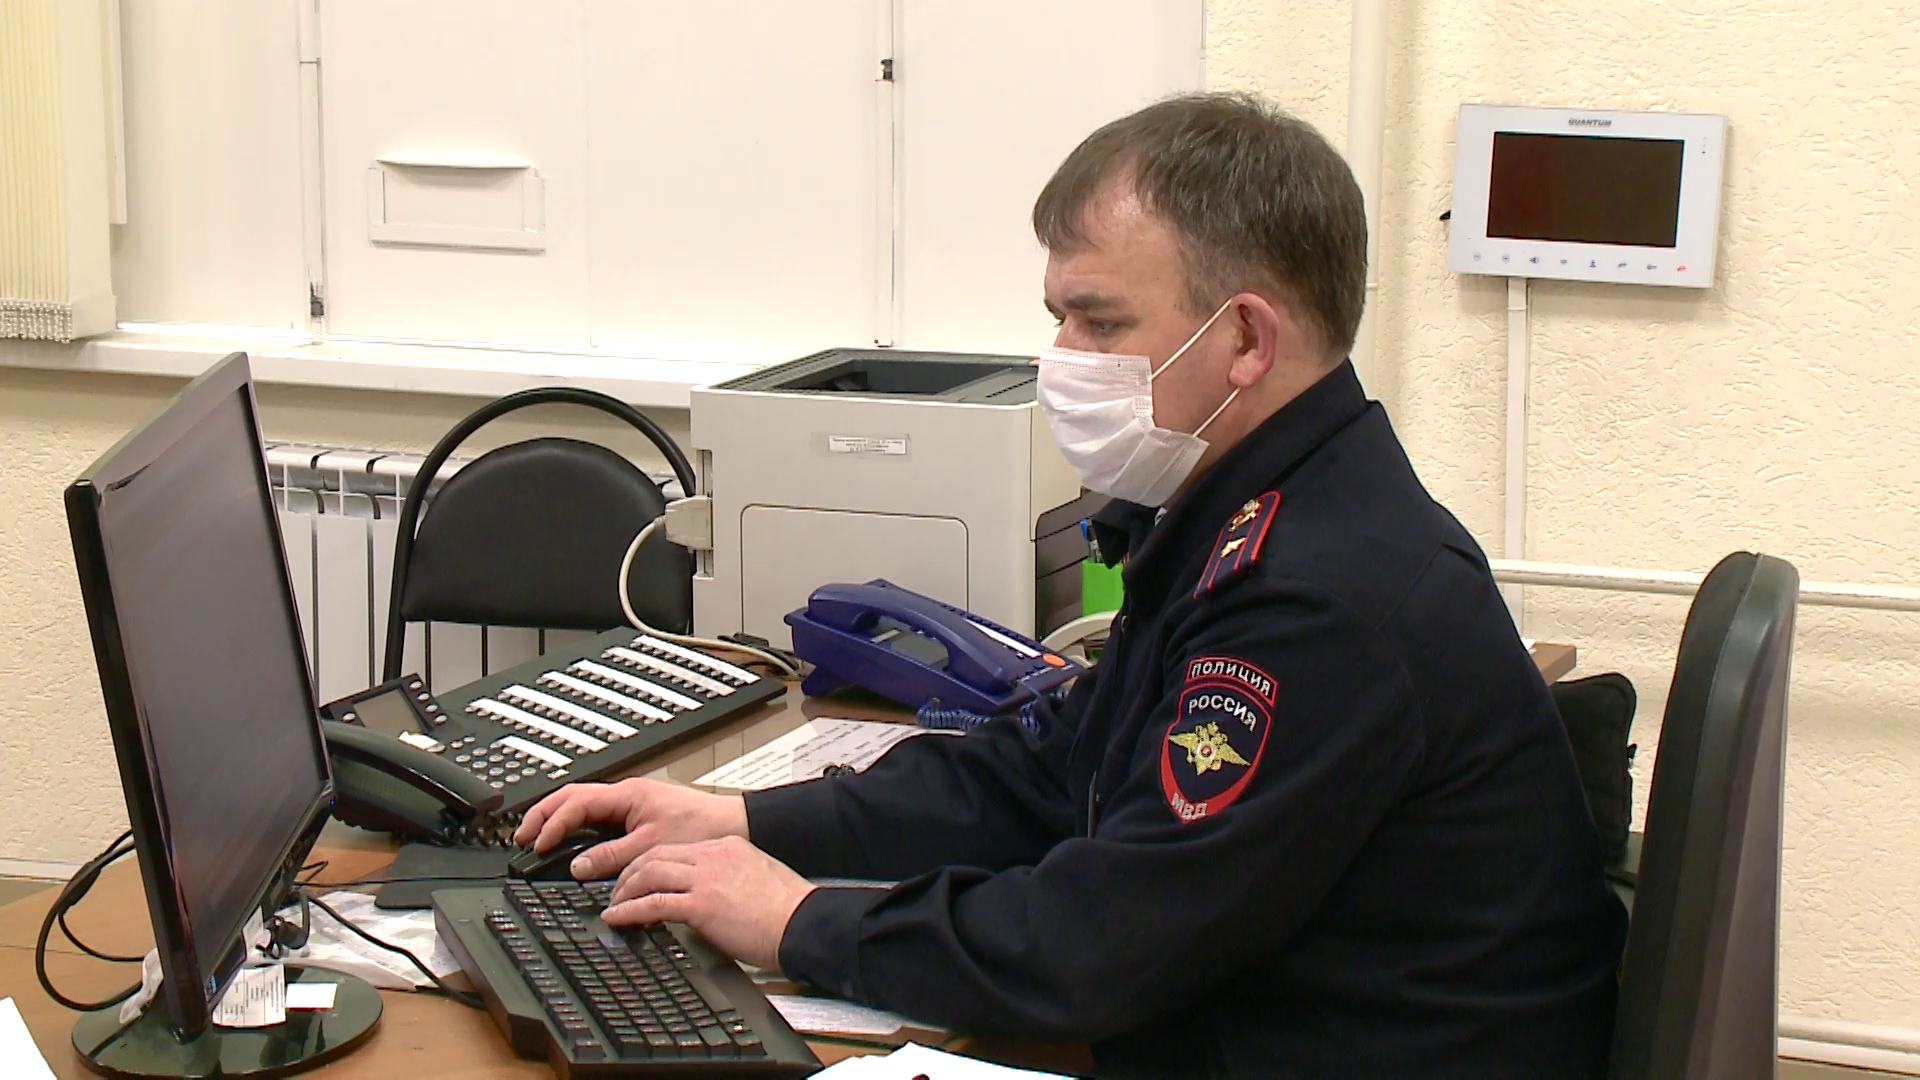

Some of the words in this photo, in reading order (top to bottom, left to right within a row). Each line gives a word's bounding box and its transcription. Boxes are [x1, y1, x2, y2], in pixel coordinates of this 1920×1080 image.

[1568, 118, 1612, 127] QUANTUM
[1191, 661, 1271, 696] ПОЛИЦИЯ
[1188, 695, 1257, 732] РОССИЯ
[1171, 791, 1208, 820] МВД
